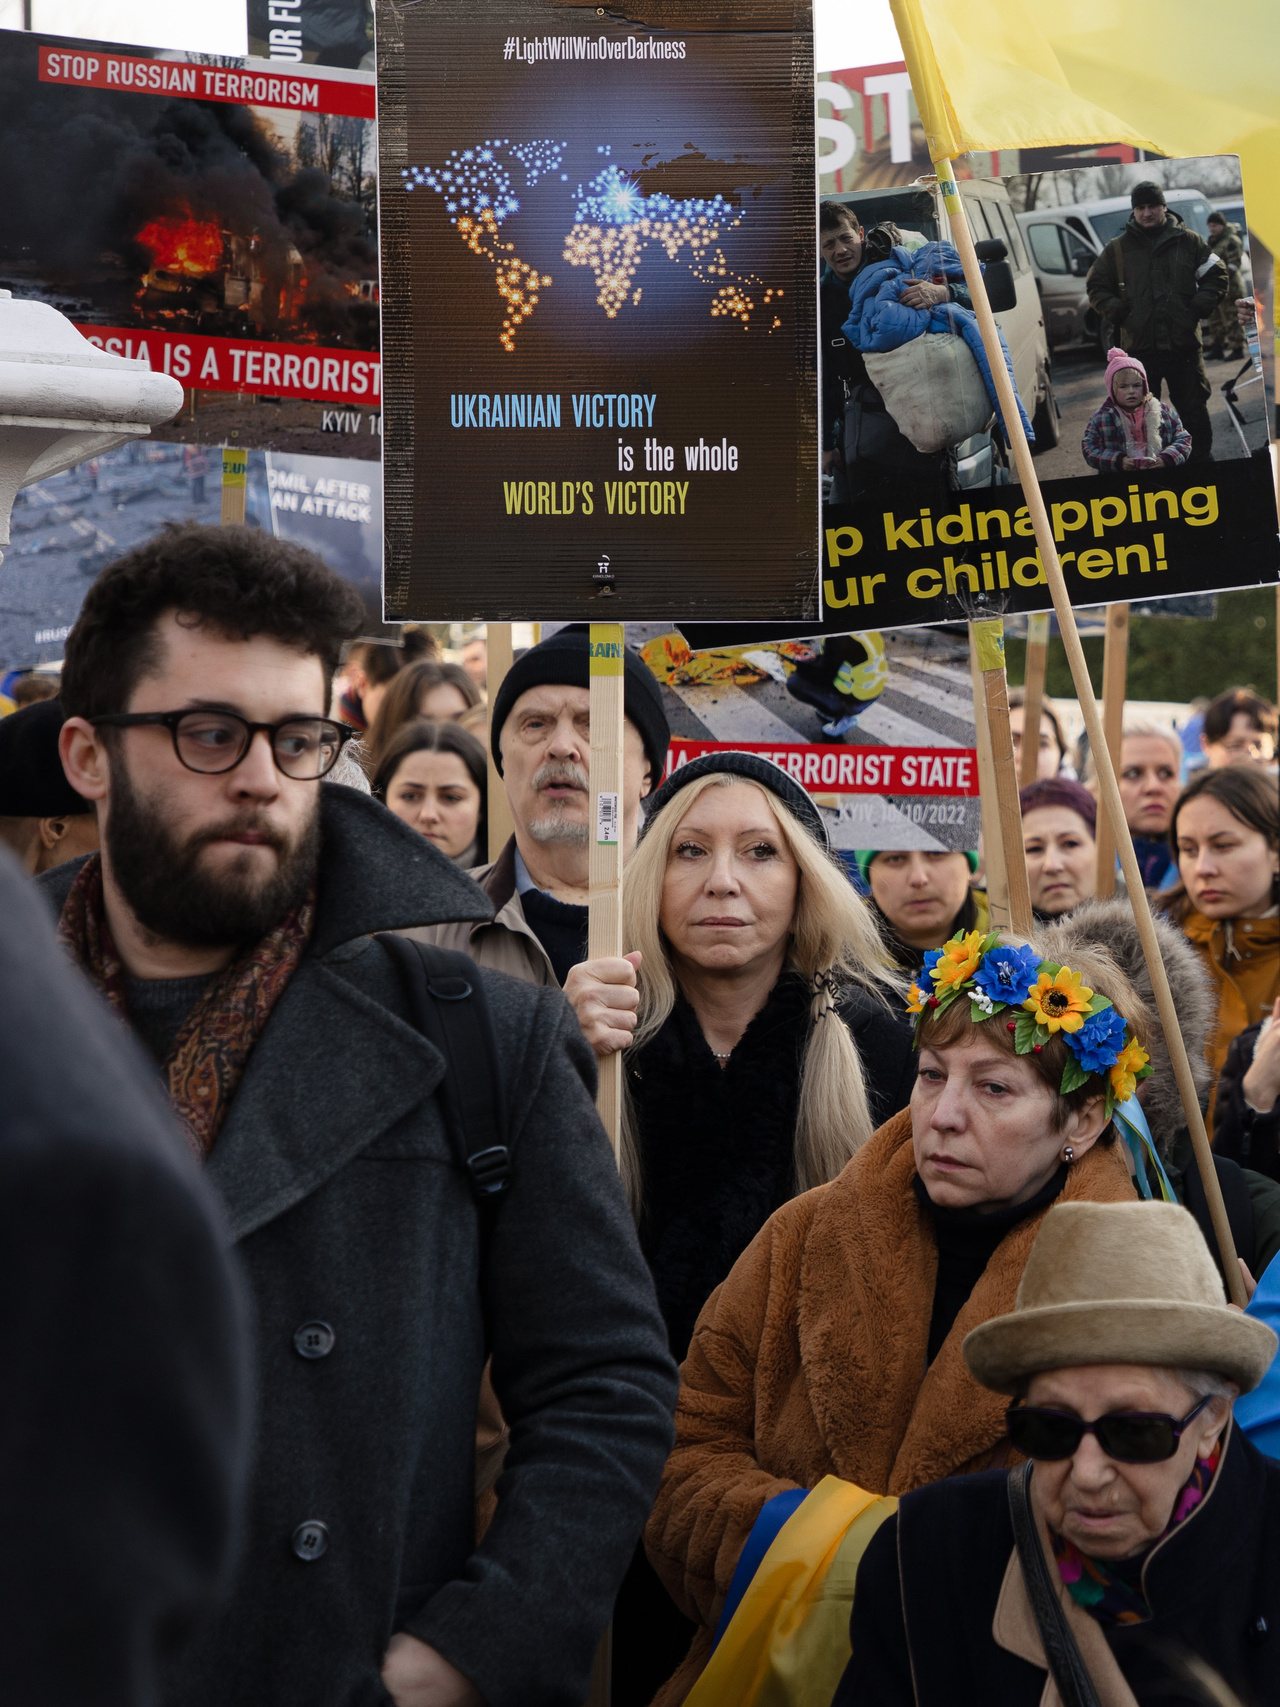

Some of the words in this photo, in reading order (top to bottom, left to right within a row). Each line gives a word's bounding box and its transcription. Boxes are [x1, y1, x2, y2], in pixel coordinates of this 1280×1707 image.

[503, 36, 686, 64] #LightWillWinOverDarkness
[47, 53, 100, 81] STOP
[107, 60, 197, 93] RUSSIAN
[202, 71, 319, 107] TERRORISM
[164, 342, 191, 378] IS
[200, 347, 220, 381] A
[229, 349, 381, 395] TERRORIST
[322, 410, 362, 434] KYIV
[450, 394, 561, 428] UKRAINIAN
[572, 394, 657, 428] VICTORY
[618, 438, 634, 471] is
[644, 438, 674, 471] the
[685, 438, 738, 471] whole
[314, 477, 372, 503] AFTER
[503, 481, 593, 515] WORLD'S
[604, 481, 689, 515] VICTORY
[301, 495, 372, 524] ATTACK
[883, 485, 1219, 551] kidnapping
[906, 533, 1169, 599] children!
[901, 755, 972, 788] STATE
[840, 803, 873, 821] KYIV
[881, 803, 966, 825] 10/10/2022
